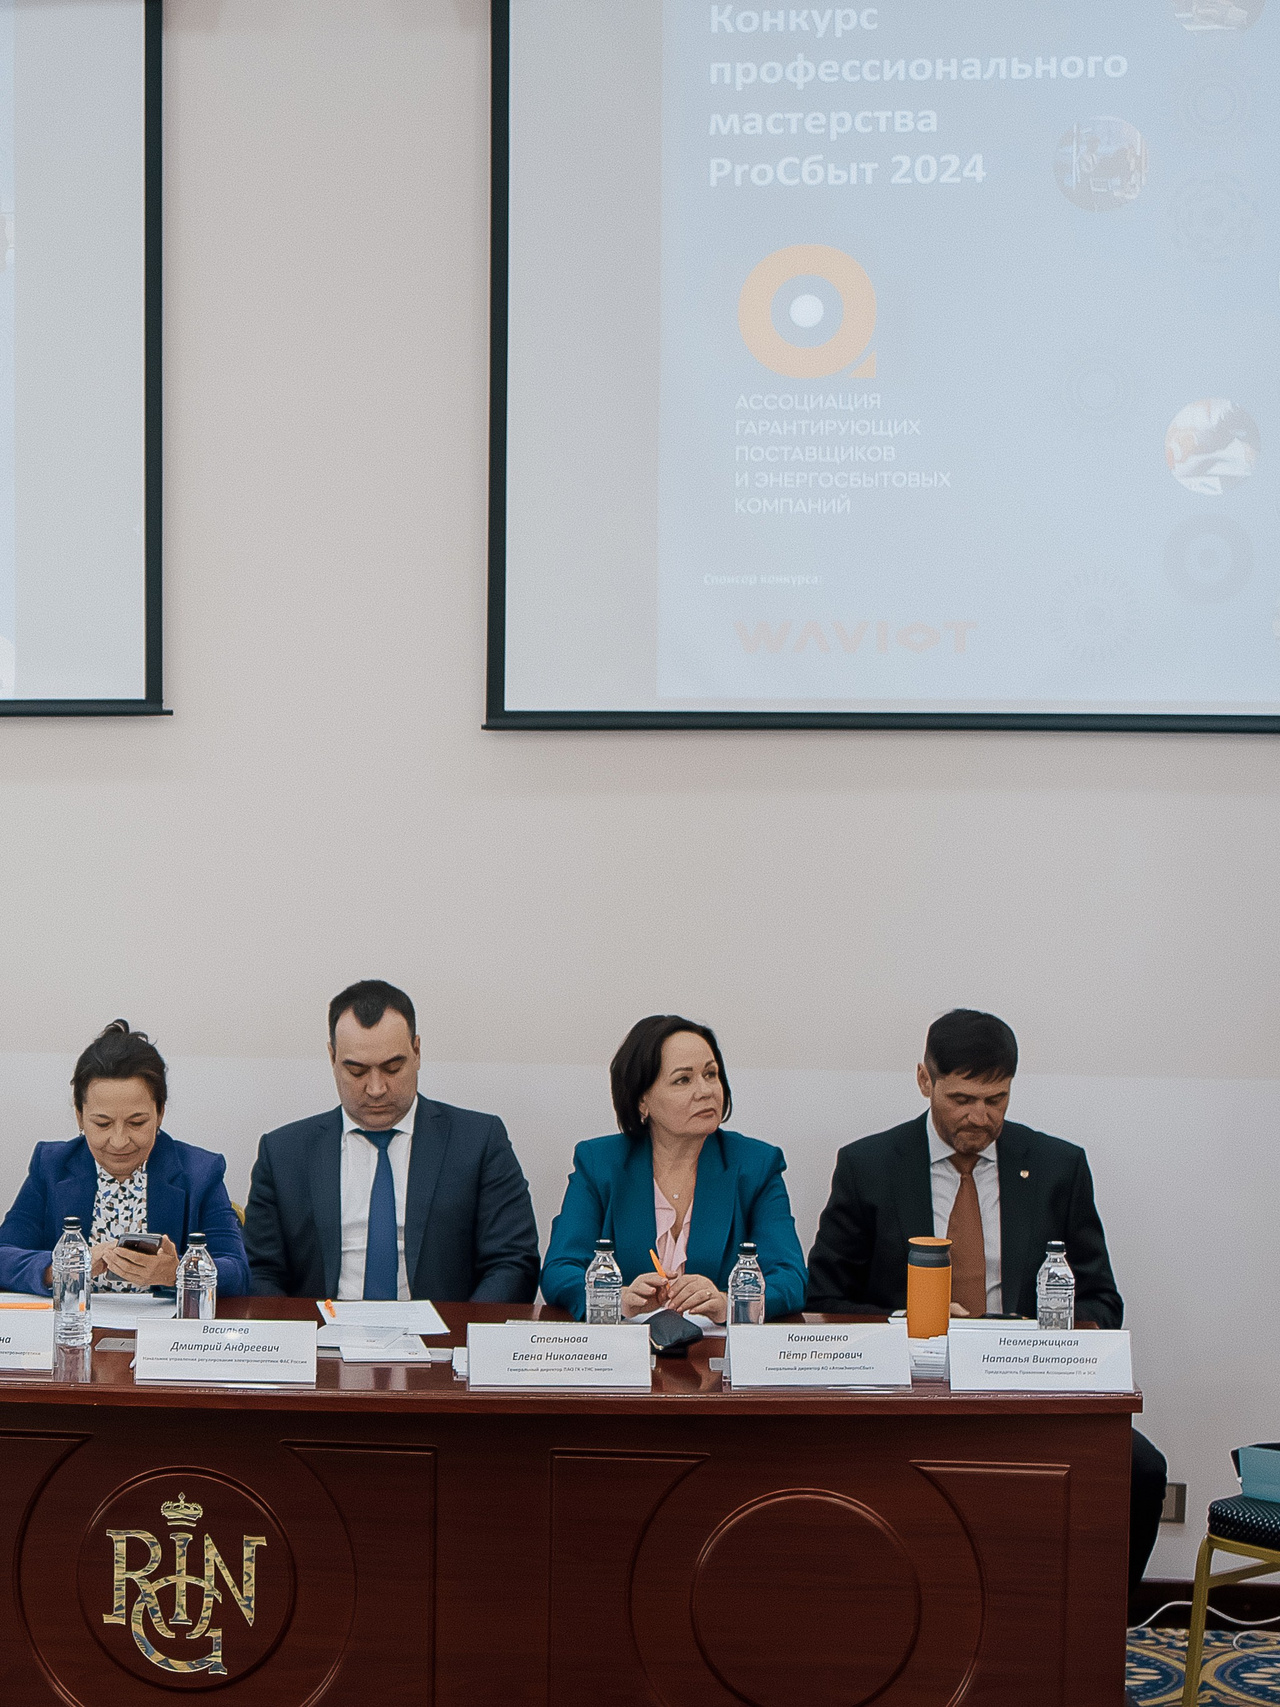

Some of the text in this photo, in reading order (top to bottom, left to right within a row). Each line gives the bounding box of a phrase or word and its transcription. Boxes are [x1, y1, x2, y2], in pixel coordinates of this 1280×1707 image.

[710, 5, 879, 38] Конкурс
[709, 51, 1129, 91] профессионального
[709, 106, 938, 141] мастерства
[890, 153, 987, 185] 2024
[735, 392, 881, 413] АССОЦИАЦИЯ
[735, 418, 921, 438] ГАРАНТИРУЮЩИХ
[735, 445, 896, 465] ПОСТАВЩИКОВ
[735, 470, 952, 488] И ЭНЕРГОСБЫТОВЫХ
[734, 493, 852, 515] КОМПАНИЙ
[703, 574, 757, 586] Спонсор
[202, 1325, 250, 1335] Васильев
[787, 1333, 849, 1342] Конюшенко
[530, 1334, 589, 1344] Стельнова
[998, 1337, 1079, 1348] Невмержицкая
[170, 1341, 280, 1353] Дмитрий Андреевич
[512, 1352, 608, 1361] Елена Николаевна
[778, 1350, 863, 1361] Пётр Петрович
[982, 1354, 1098, 1365] Наталья Викторовна
